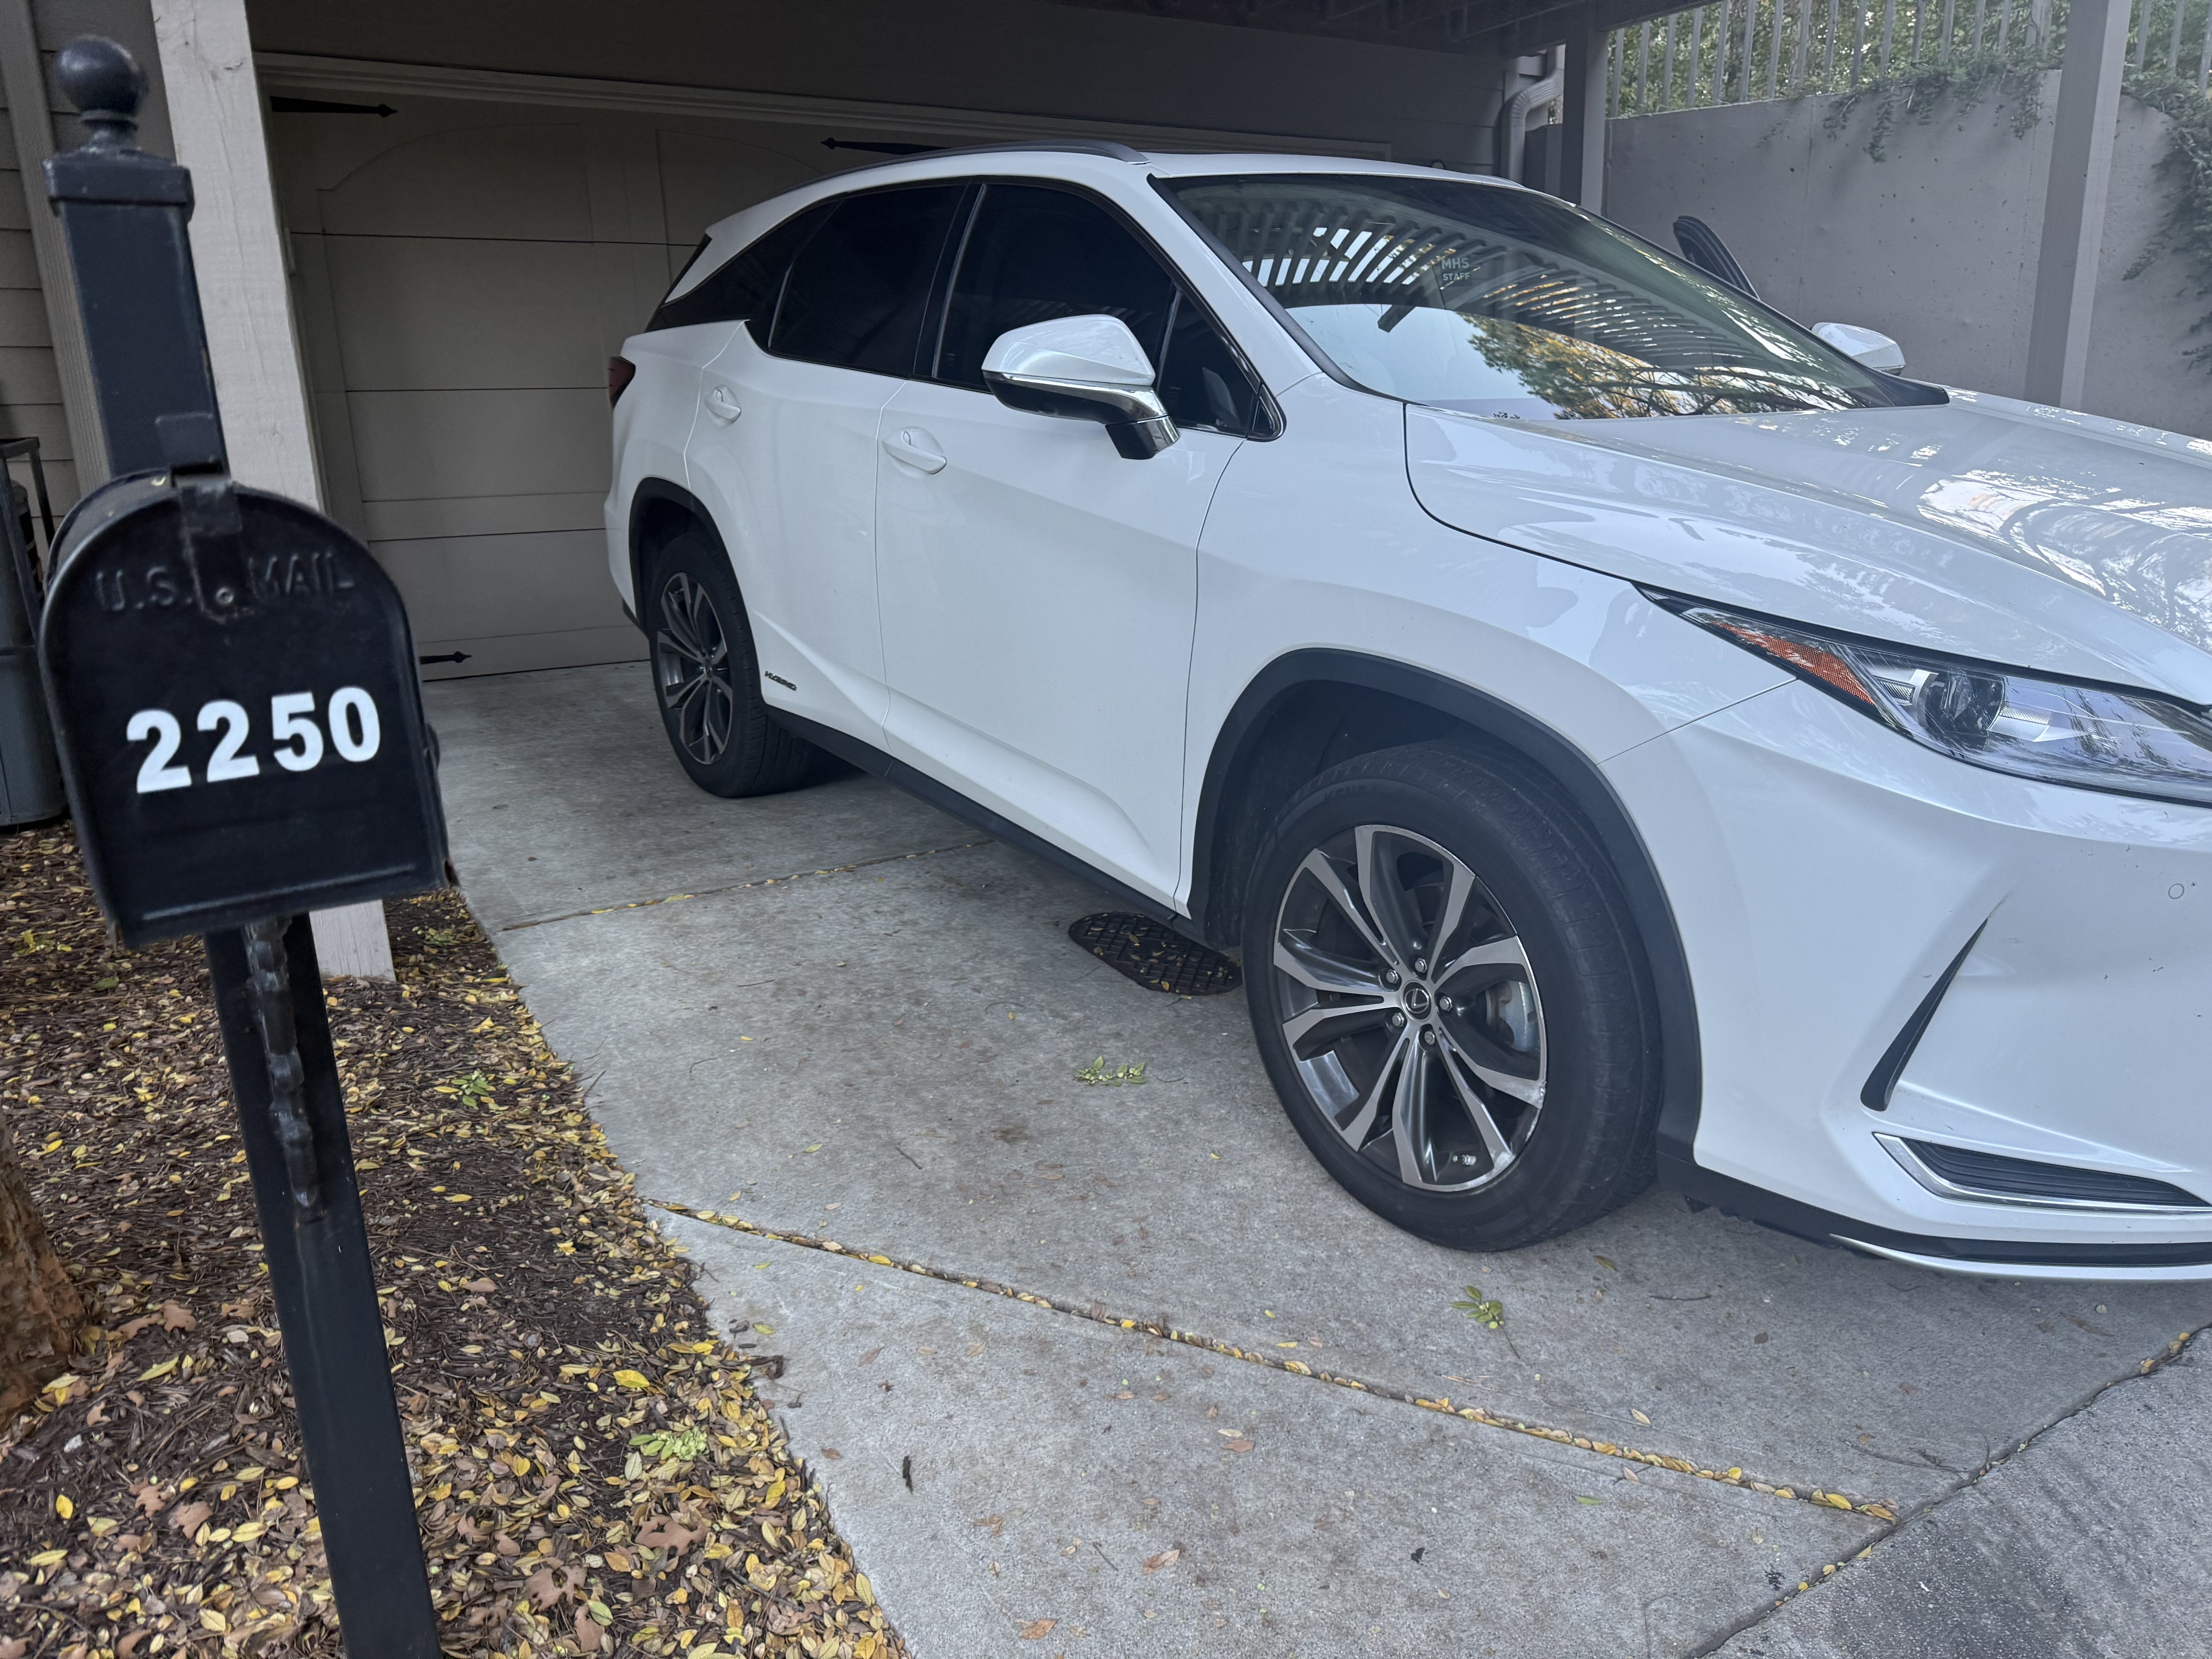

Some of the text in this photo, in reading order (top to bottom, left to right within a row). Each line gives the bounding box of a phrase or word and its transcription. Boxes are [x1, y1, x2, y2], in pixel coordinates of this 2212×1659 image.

[1441, 258, 1469, 269] MHS
[1443, 272, 1470, 281] STAFF
[95, 553, 356, 611] U.S. MAIL
[126, 685, 381, 793] 2250
